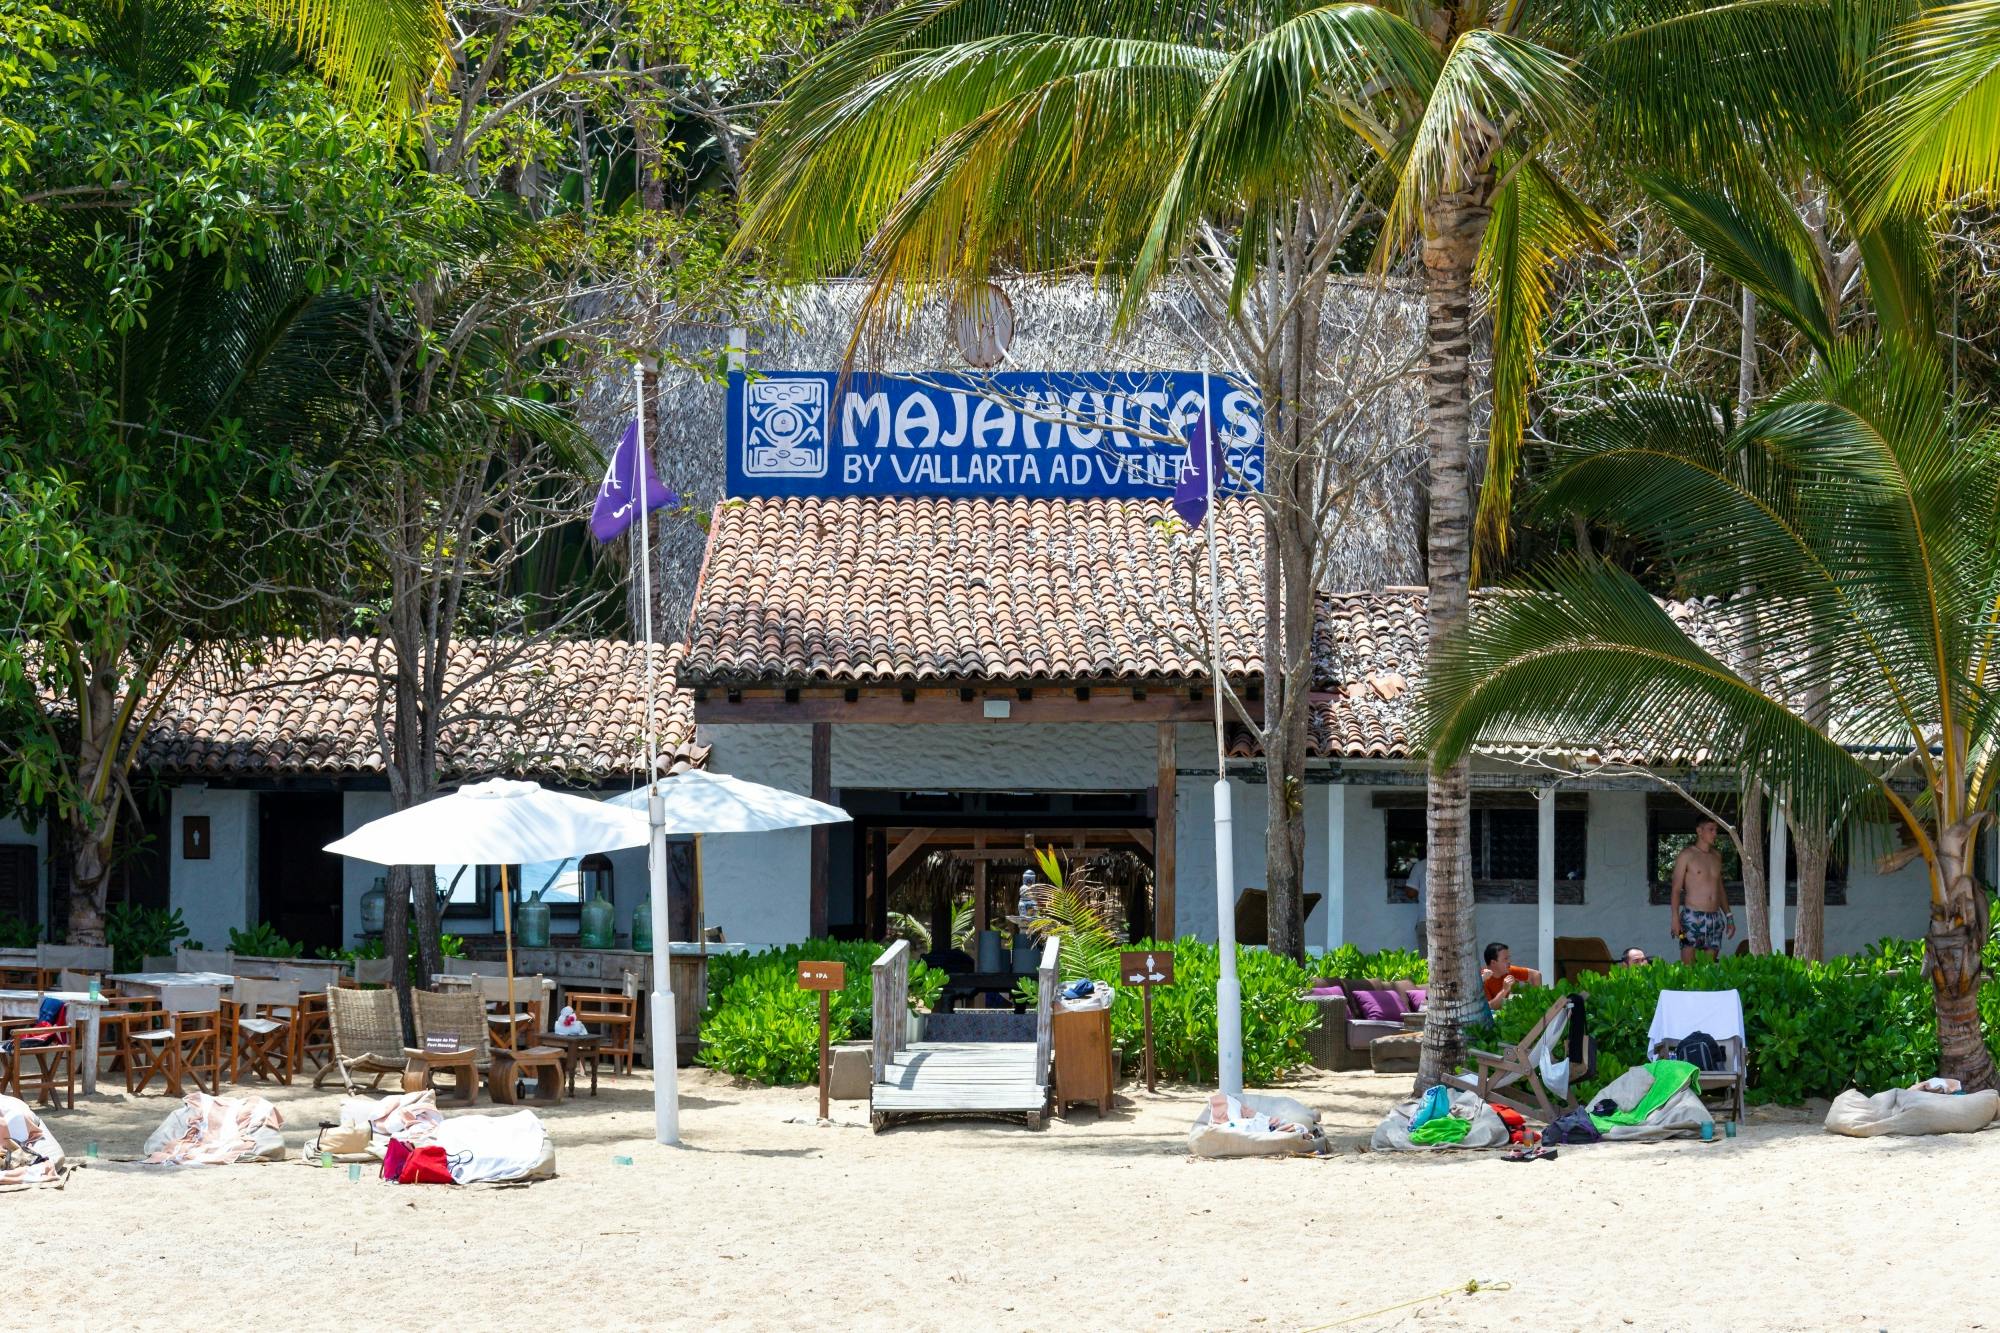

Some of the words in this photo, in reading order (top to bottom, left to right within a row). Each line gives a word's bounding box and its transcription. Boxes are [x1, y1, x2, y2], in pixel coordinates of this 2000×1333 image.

[842, 390, 1262, 449] MAJAHUITAS
[843, 454, 882, 484] BY
[890, 453, 1041, 484] VALLARTA
[1050, 454, 1262, 485] ADVENTES
